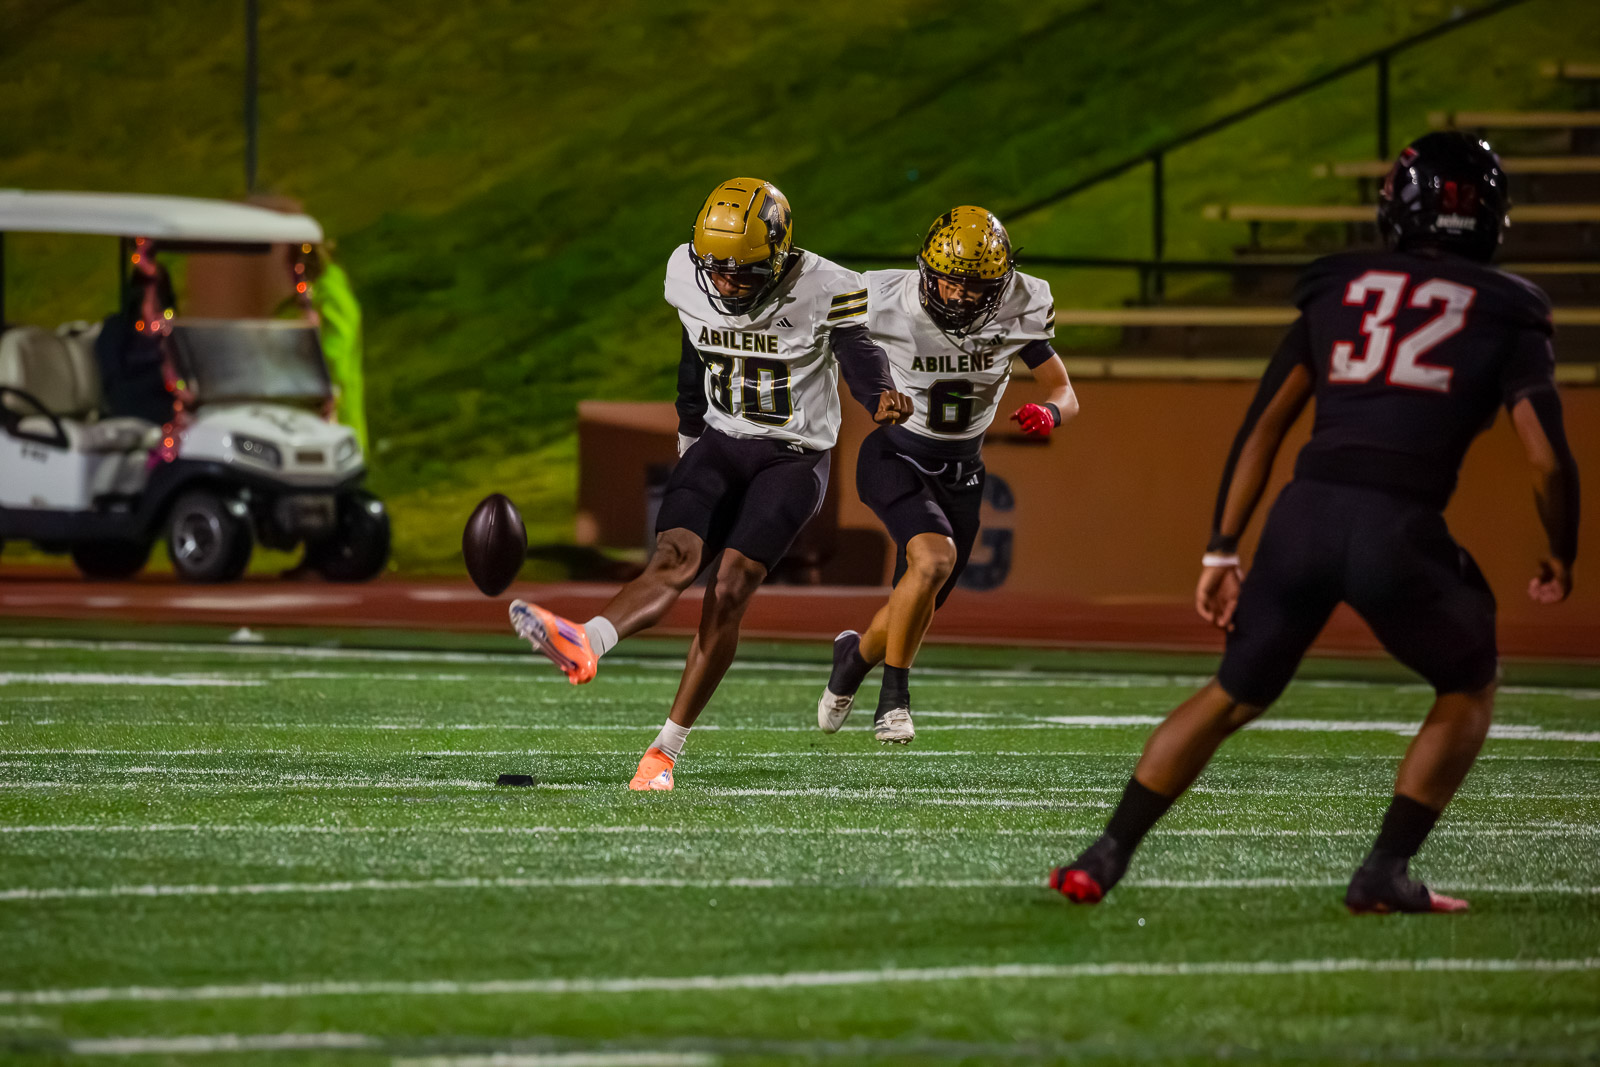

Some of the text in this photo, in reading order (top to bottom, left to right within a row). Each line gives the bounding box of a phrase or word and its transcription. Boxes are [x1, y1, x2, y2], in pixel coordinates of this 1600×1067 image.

[698, 326, 778, 354] ABILENE
[1328, 269, 1477, 393] 32
[911, 351, 994, 373] ABILENE
[926, 378, 974, 434] 6
